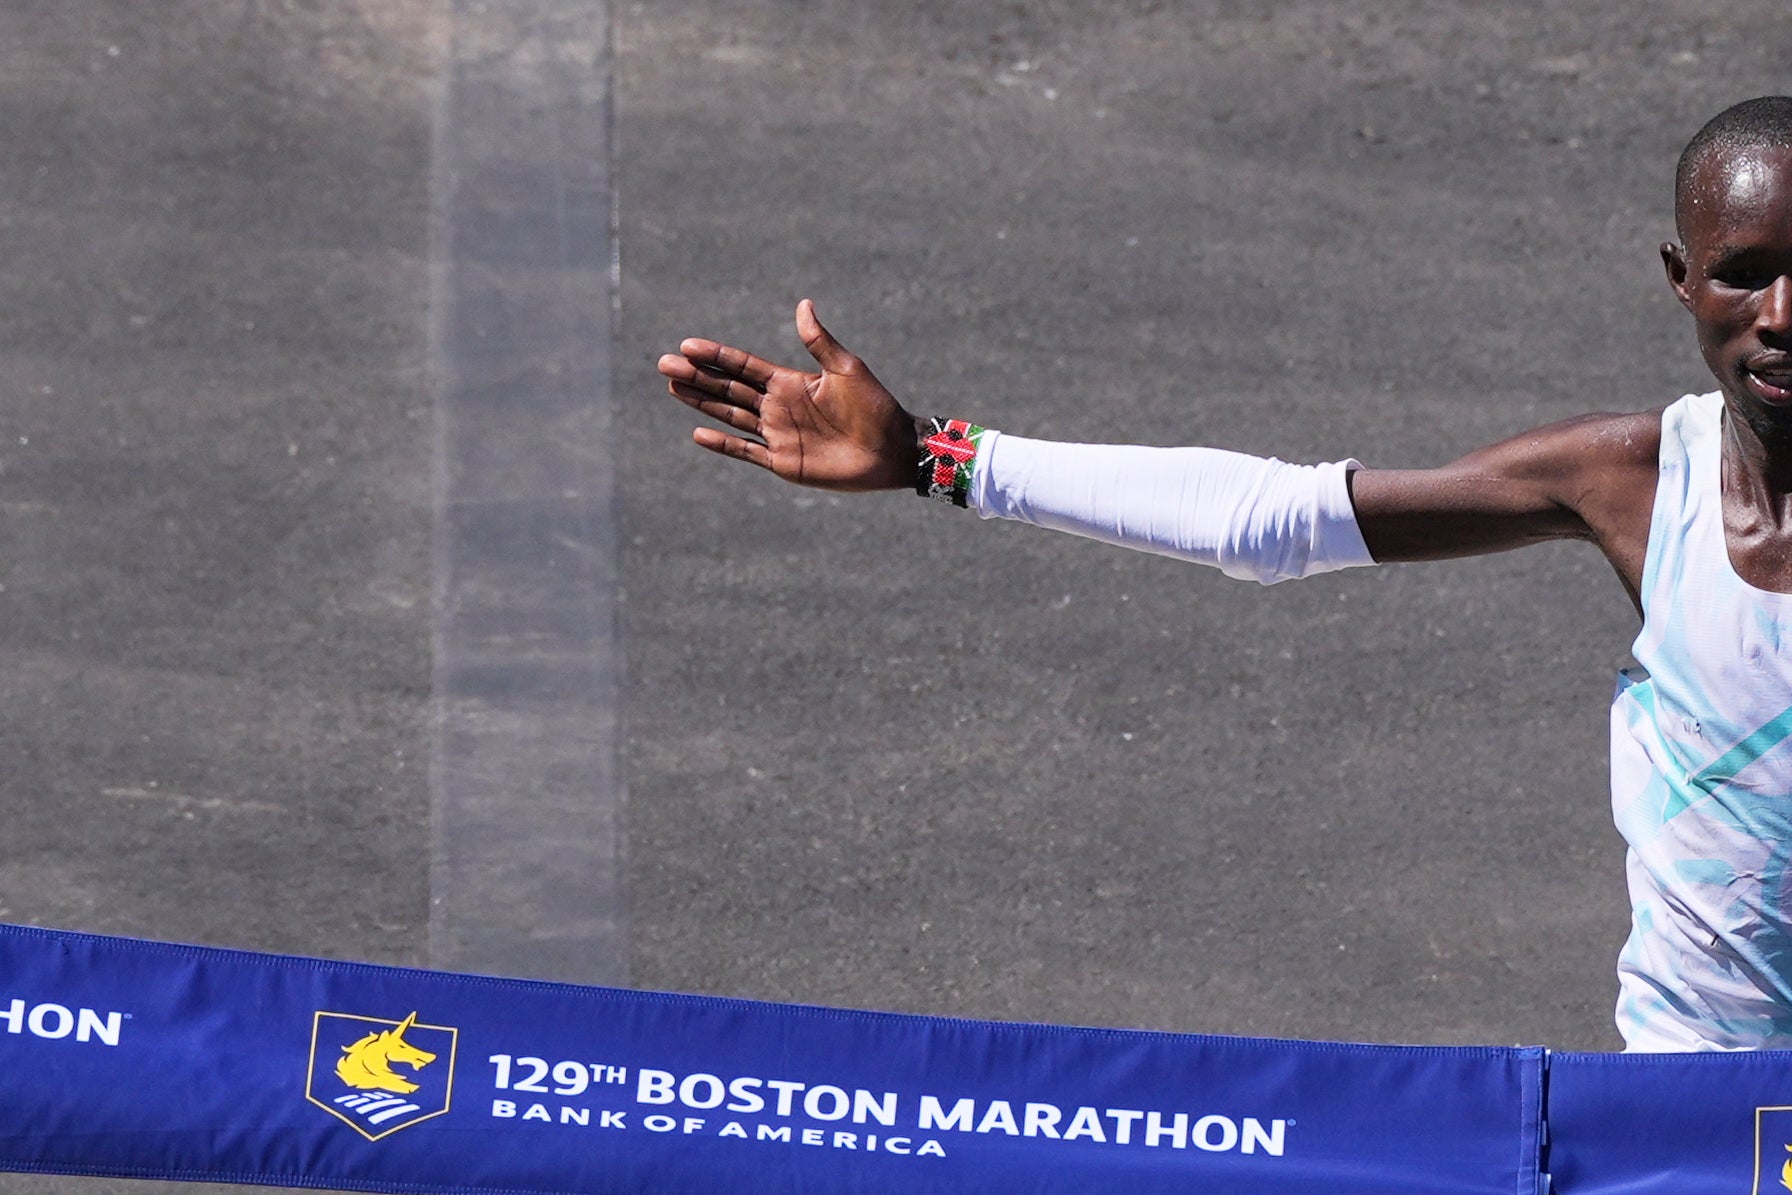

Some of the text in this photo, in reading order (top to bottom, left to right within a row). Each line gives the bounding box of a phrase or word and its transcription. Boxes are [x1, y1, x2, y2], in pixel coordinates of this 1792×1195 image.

[488, 1054, 1286, 1157] 129TH BOSTON MARATHON
[492, 1099, 946, 1158] BANK OF AMERICA
